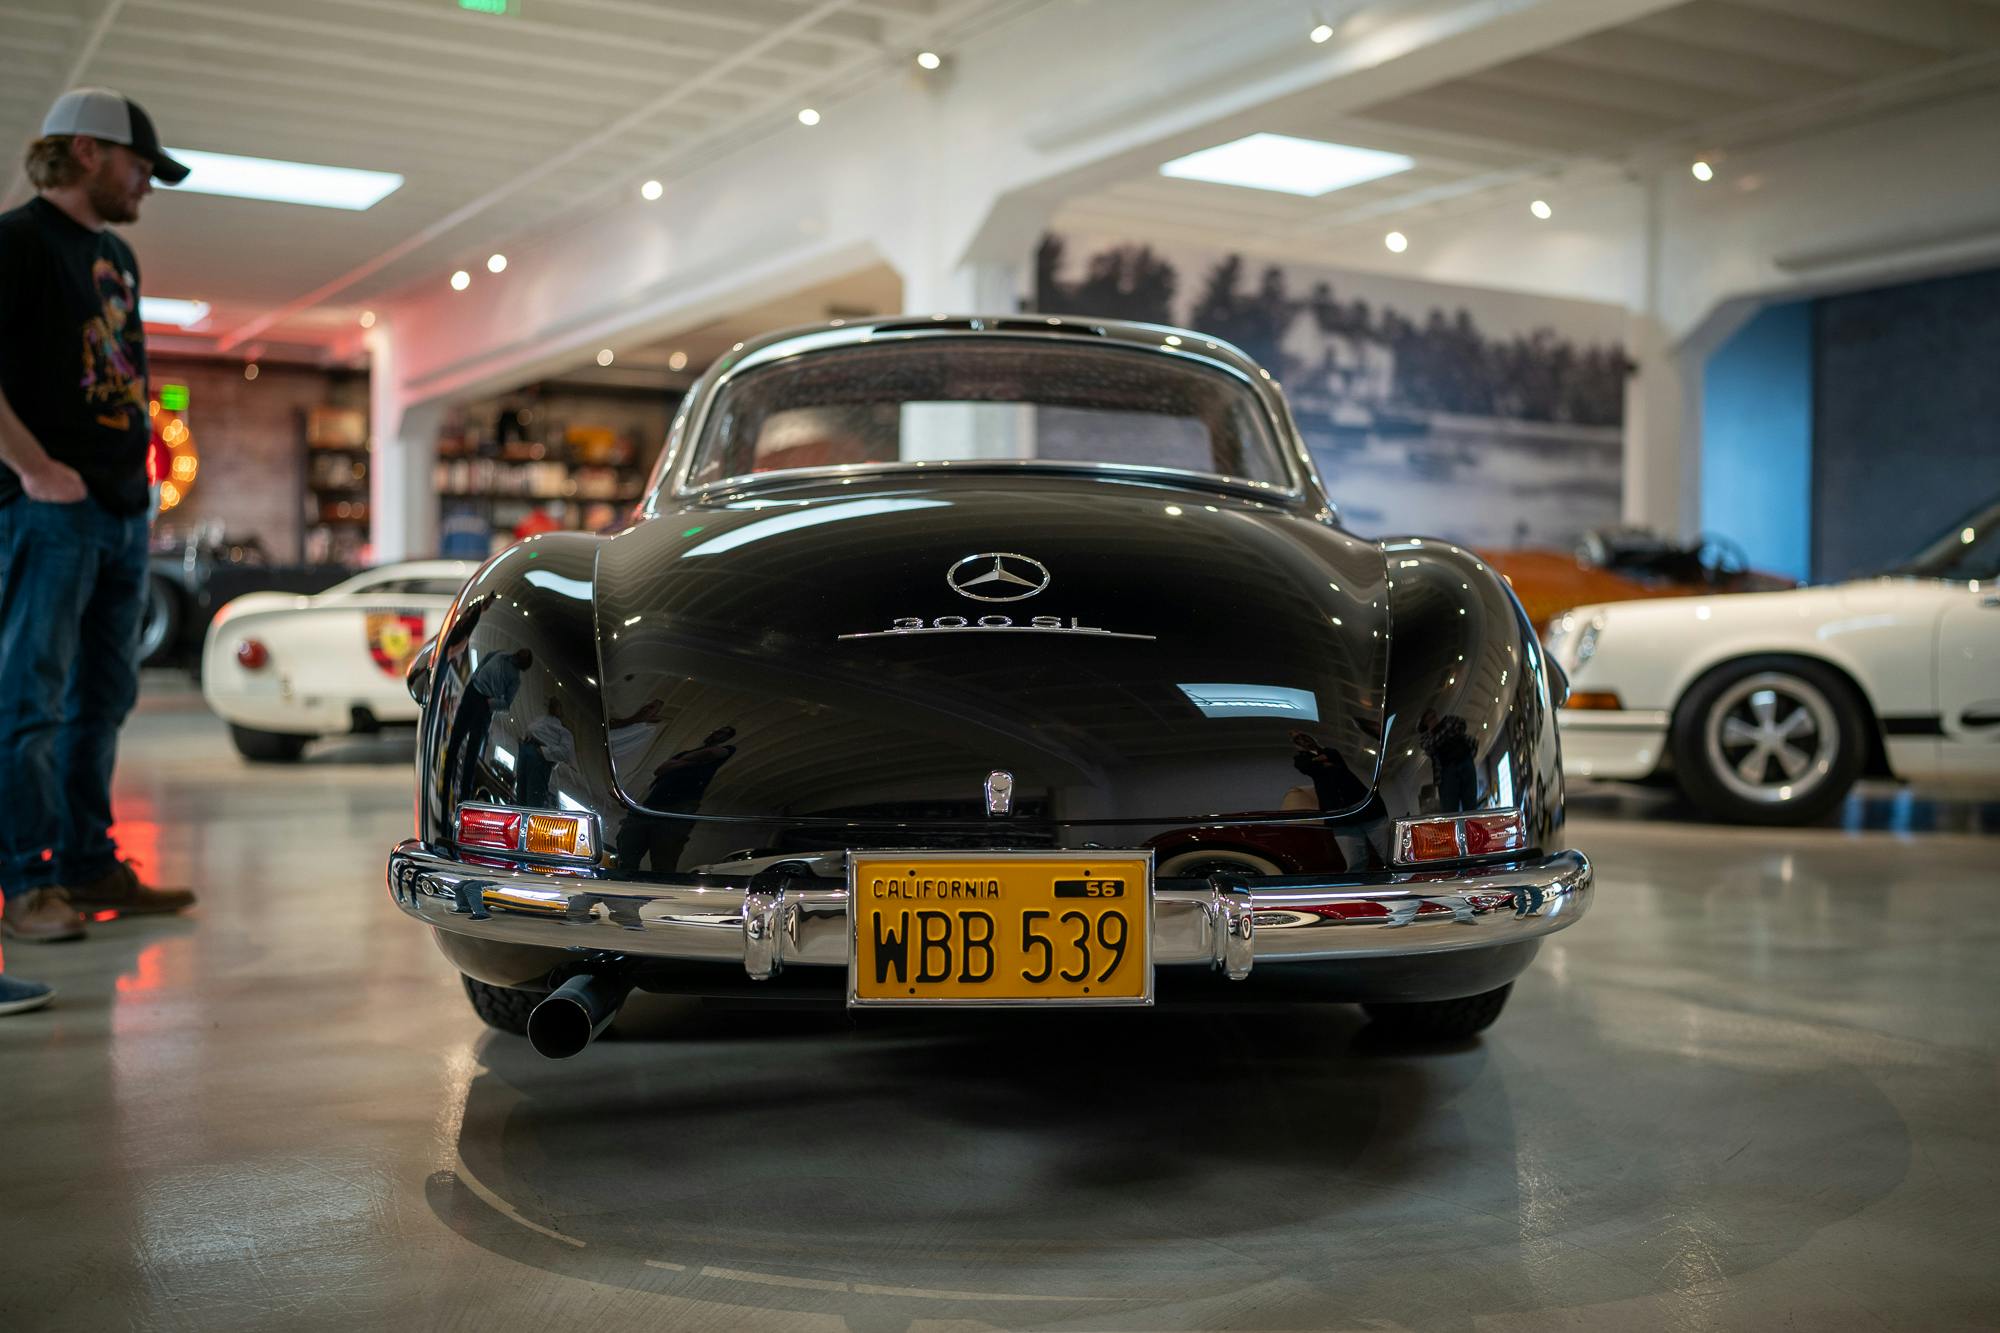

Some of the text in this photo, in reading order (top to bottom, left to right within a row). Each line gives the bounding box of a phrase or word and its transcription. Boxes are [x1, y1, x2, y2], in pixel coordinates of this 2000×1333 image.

[893, 615, 1102, 631] 300 SL
[873, 880, 999, 898] CALIFORNIA
[1086, 881, 1116, 896] 56
[872, 911, 1128, 984] WBB 539
